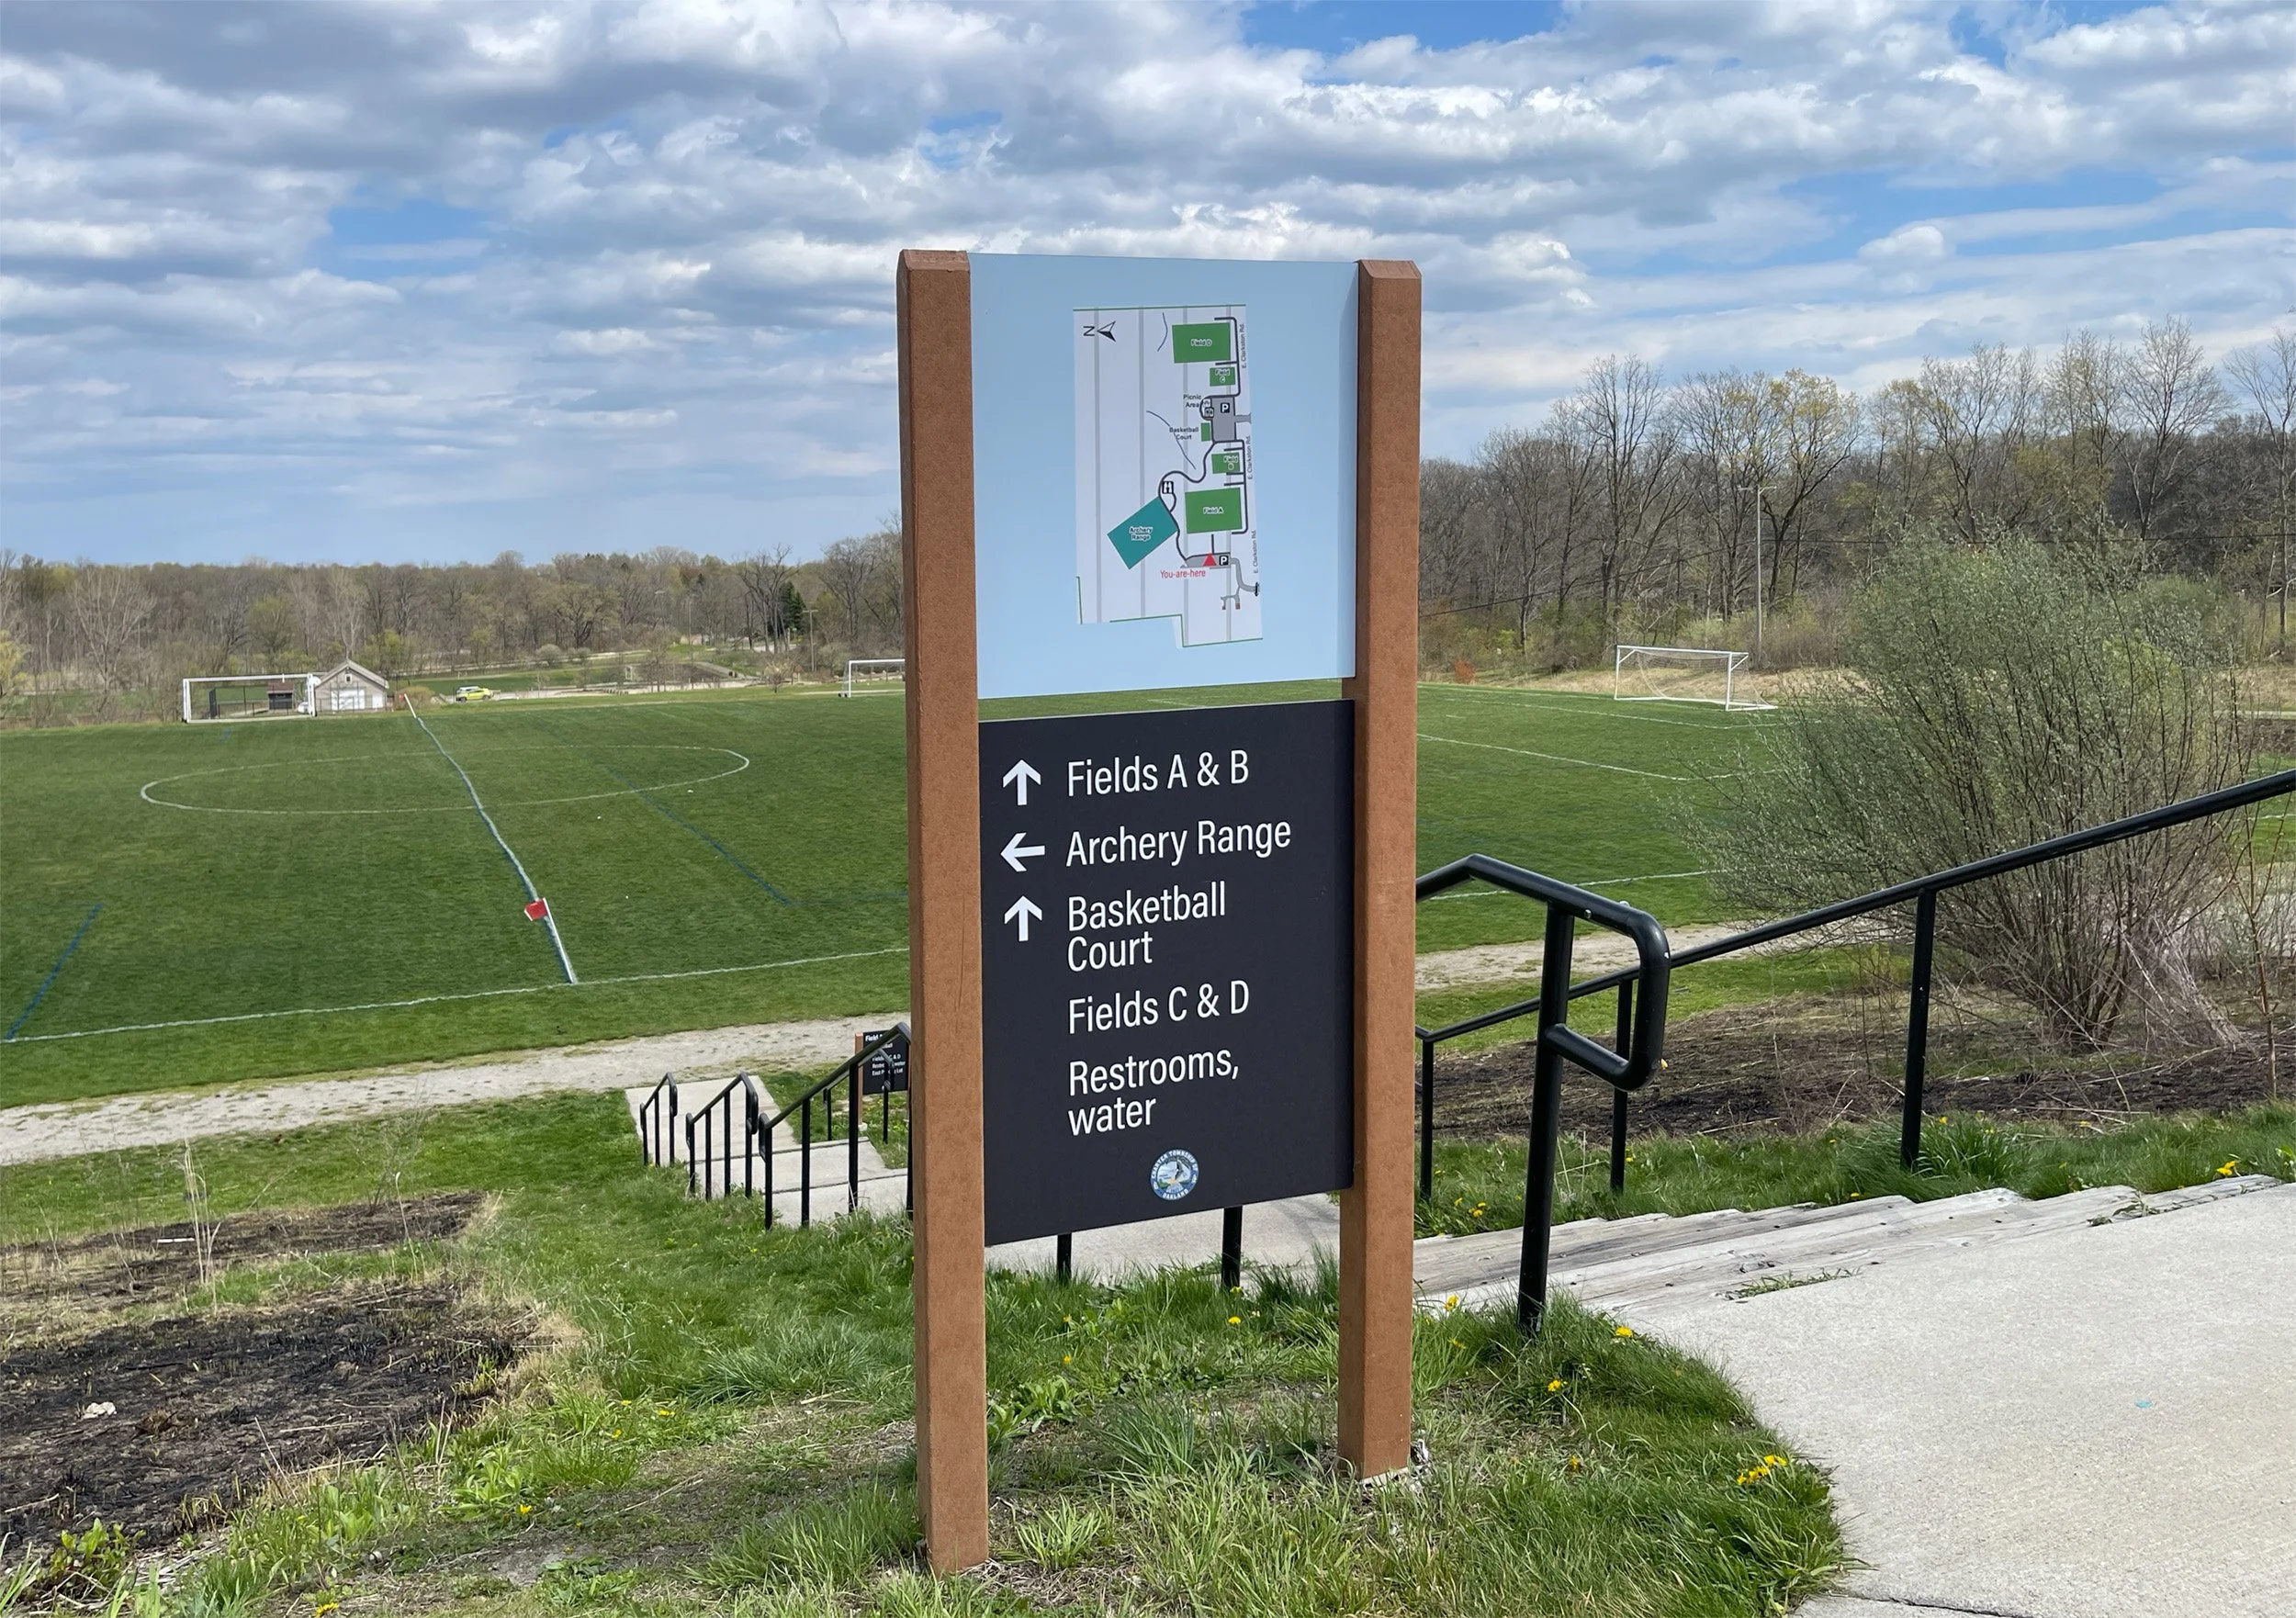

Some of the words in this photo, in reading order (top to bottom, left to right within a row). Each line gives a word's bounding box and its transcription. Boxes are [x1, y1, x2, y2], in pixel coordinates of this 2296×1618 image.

[1083, 325, 1096, 337] N
[1221, 404, 1229, 412] P
[1129, 526, 1153, 534] Archery
[1131, 534, 1151, 542] Range
[1221, 556, 1227, 565] P
[1160, 569, 1206, 579] You-are-here
[1067, 756, 1158, 797] Fields
[1167, 754, 1187, 789] A
[1197, 751, 1220, 786] &
[1231, 749, 1249, 784] B
[1065, 826, 1188, 867] Archery
[1197, 820, 1291, 858] Range
[1068, 881, 1226, 932] Basketball
[1067, 931, 1153, 972] Court
[1068, 990, 1158, 1034] Fields
[1168, 986, 1187, 1022] C
[1197, 983, 1220, 1017] &
[1231, 980, 1250, 1014] D
[1069, 1049, 1240, 1096] Restrooms,
[1068, 1097, 1156, 1136] water
[1162, 1188, 1189, 1201] OAKLAND
